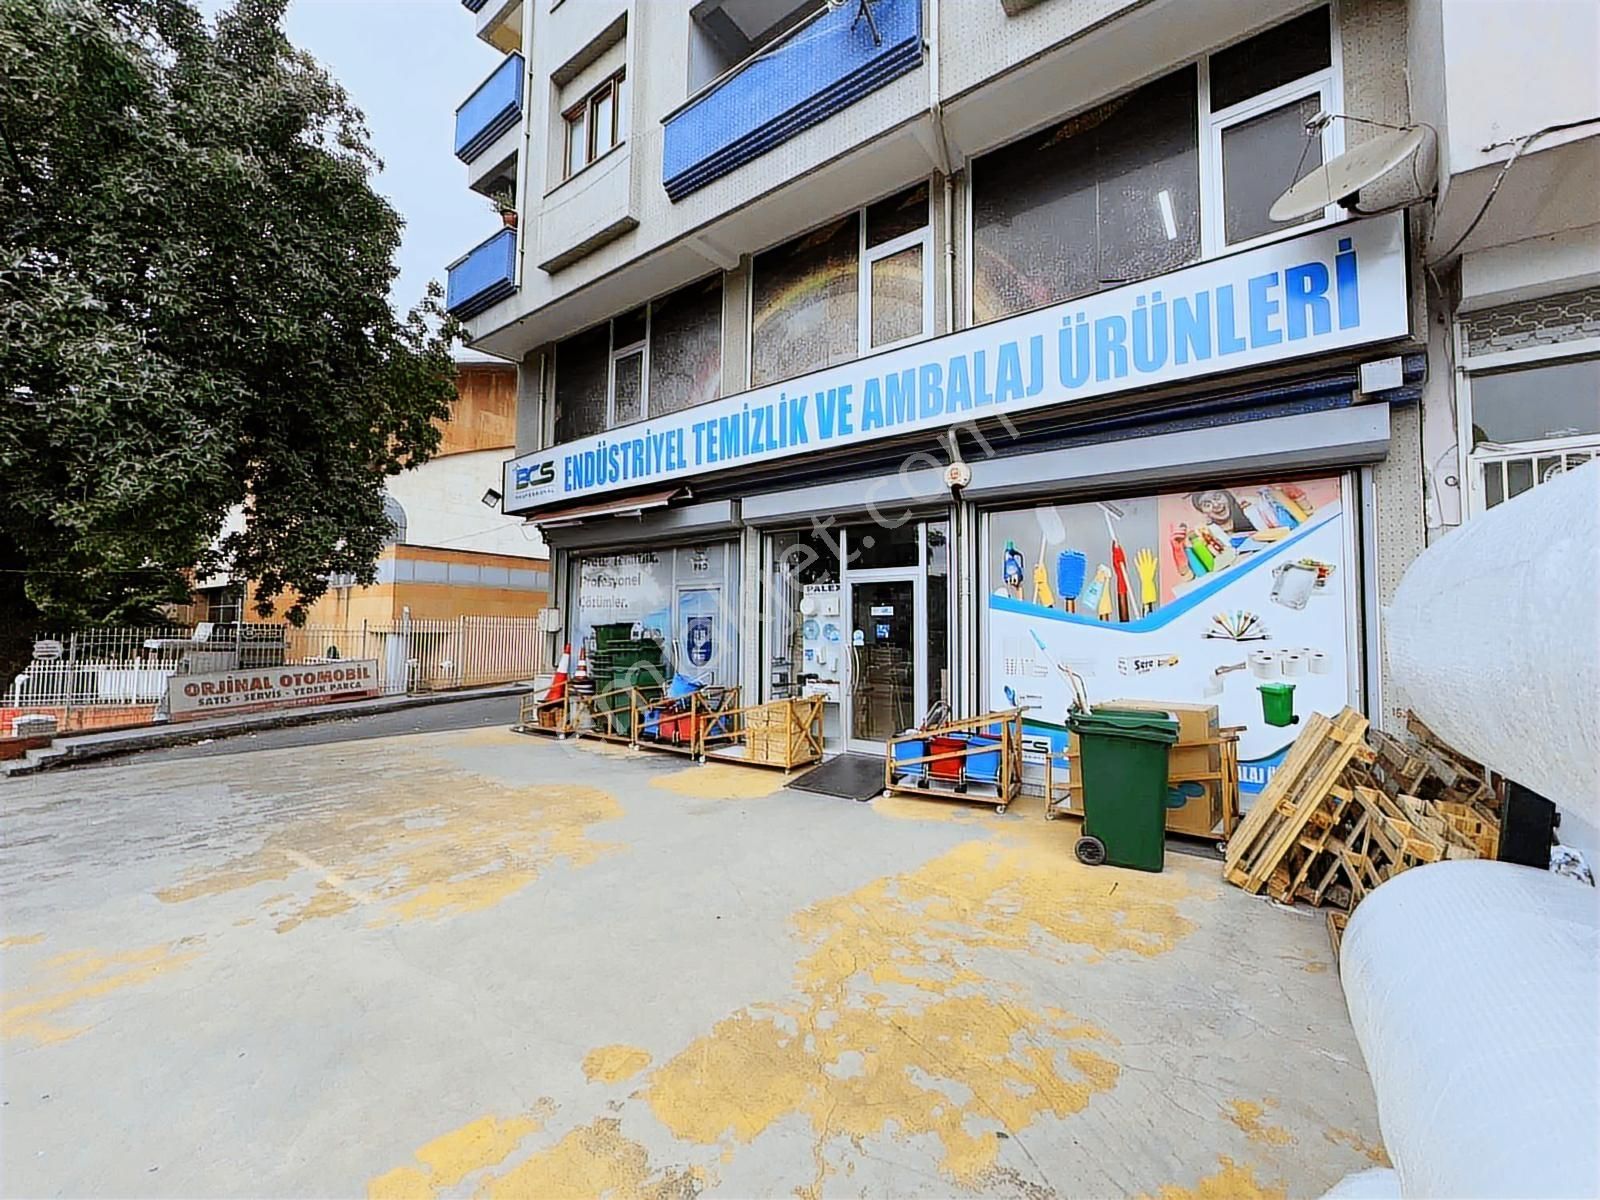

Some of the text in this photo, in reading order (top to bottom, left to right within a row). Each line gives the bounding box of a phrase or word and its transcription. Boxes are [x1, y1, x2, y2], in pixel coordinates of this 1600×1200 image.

[564, 237, 1360, 492] ENDÜSTRİYEL TEMİZLİK VE AMBALAJ ÜRÜNLERİ
[184, 664, 371, 697] ORJİNAL OTOMOBİL
[244, 687, 282, 702] SERVİS
[294, 683, 327, 696] YEDEK
